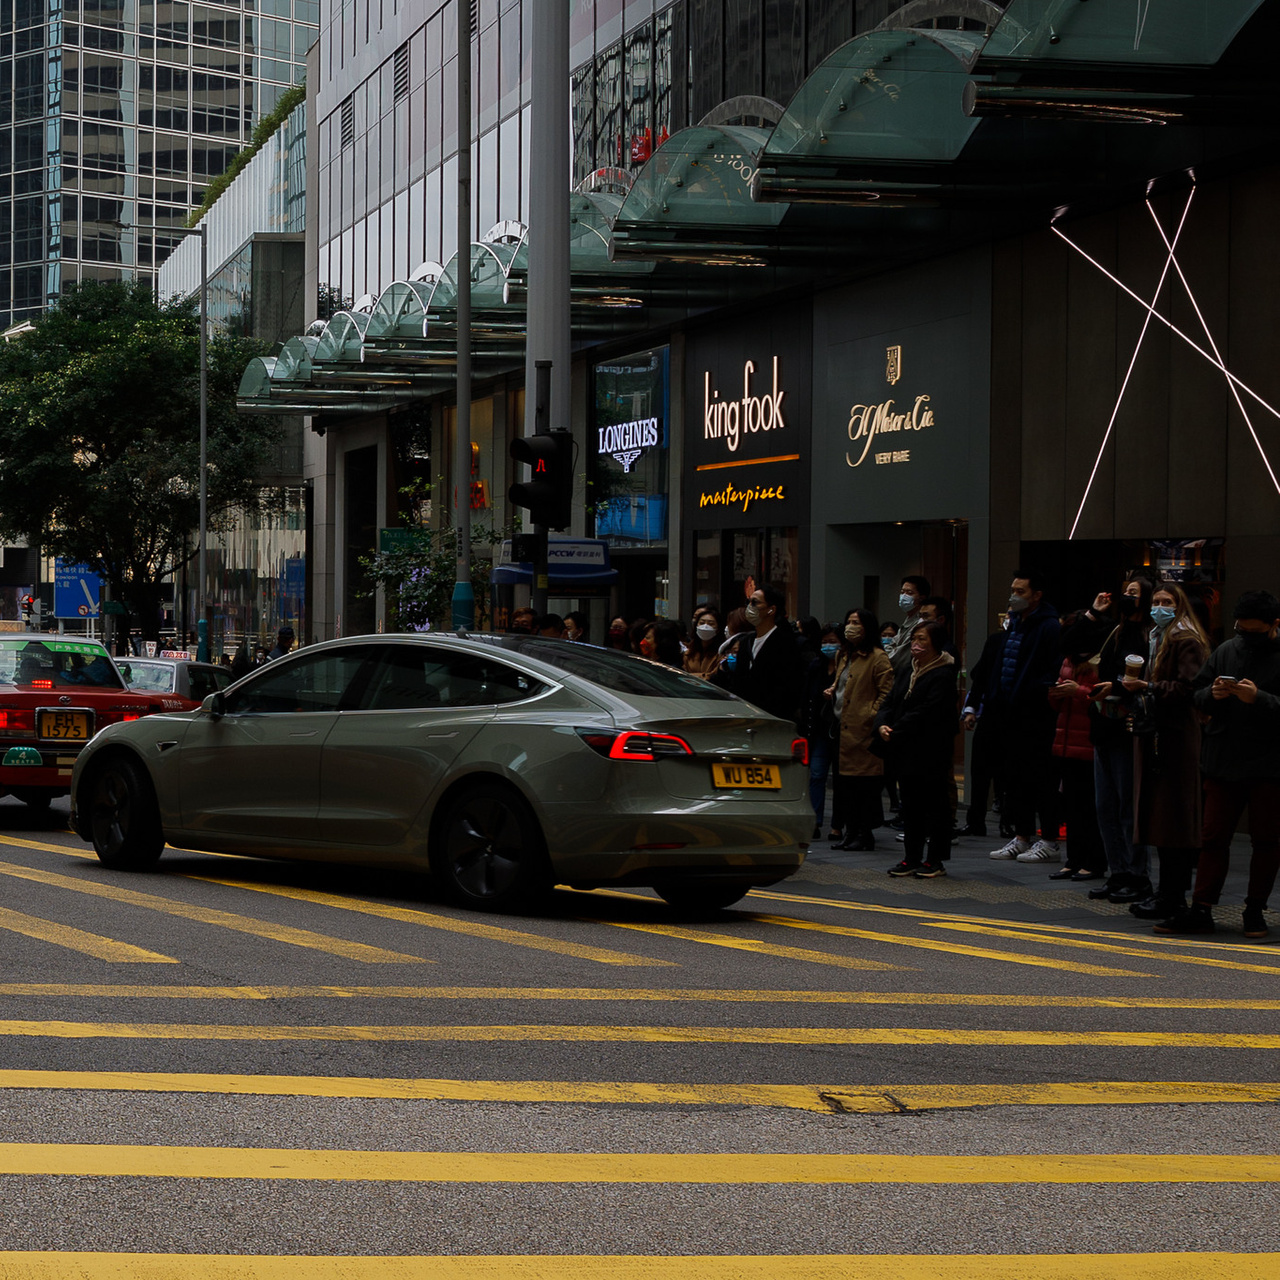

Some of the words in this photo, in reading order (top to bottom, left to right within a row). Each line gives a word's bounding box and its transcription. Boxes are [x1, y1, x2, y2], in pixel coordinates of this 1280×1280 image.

[704, 369, 740, 452] king
[741, 357, 786, 434] fook
[598, 417, 658, 454] LONGINES
[874, 452, 892, 465] VERY
[892, 450, 910, 463] RARE
[699, 482, 786, 513] masterpiece
[162, 650, 188, 659] TAXI
[54, 715, 74, 726] EH
[46, 726, 81, 738] 1575
[19, 751, 27, 759] 4
[722, 767, 742, 783] WU
[746, 767, 772, 784] 854
